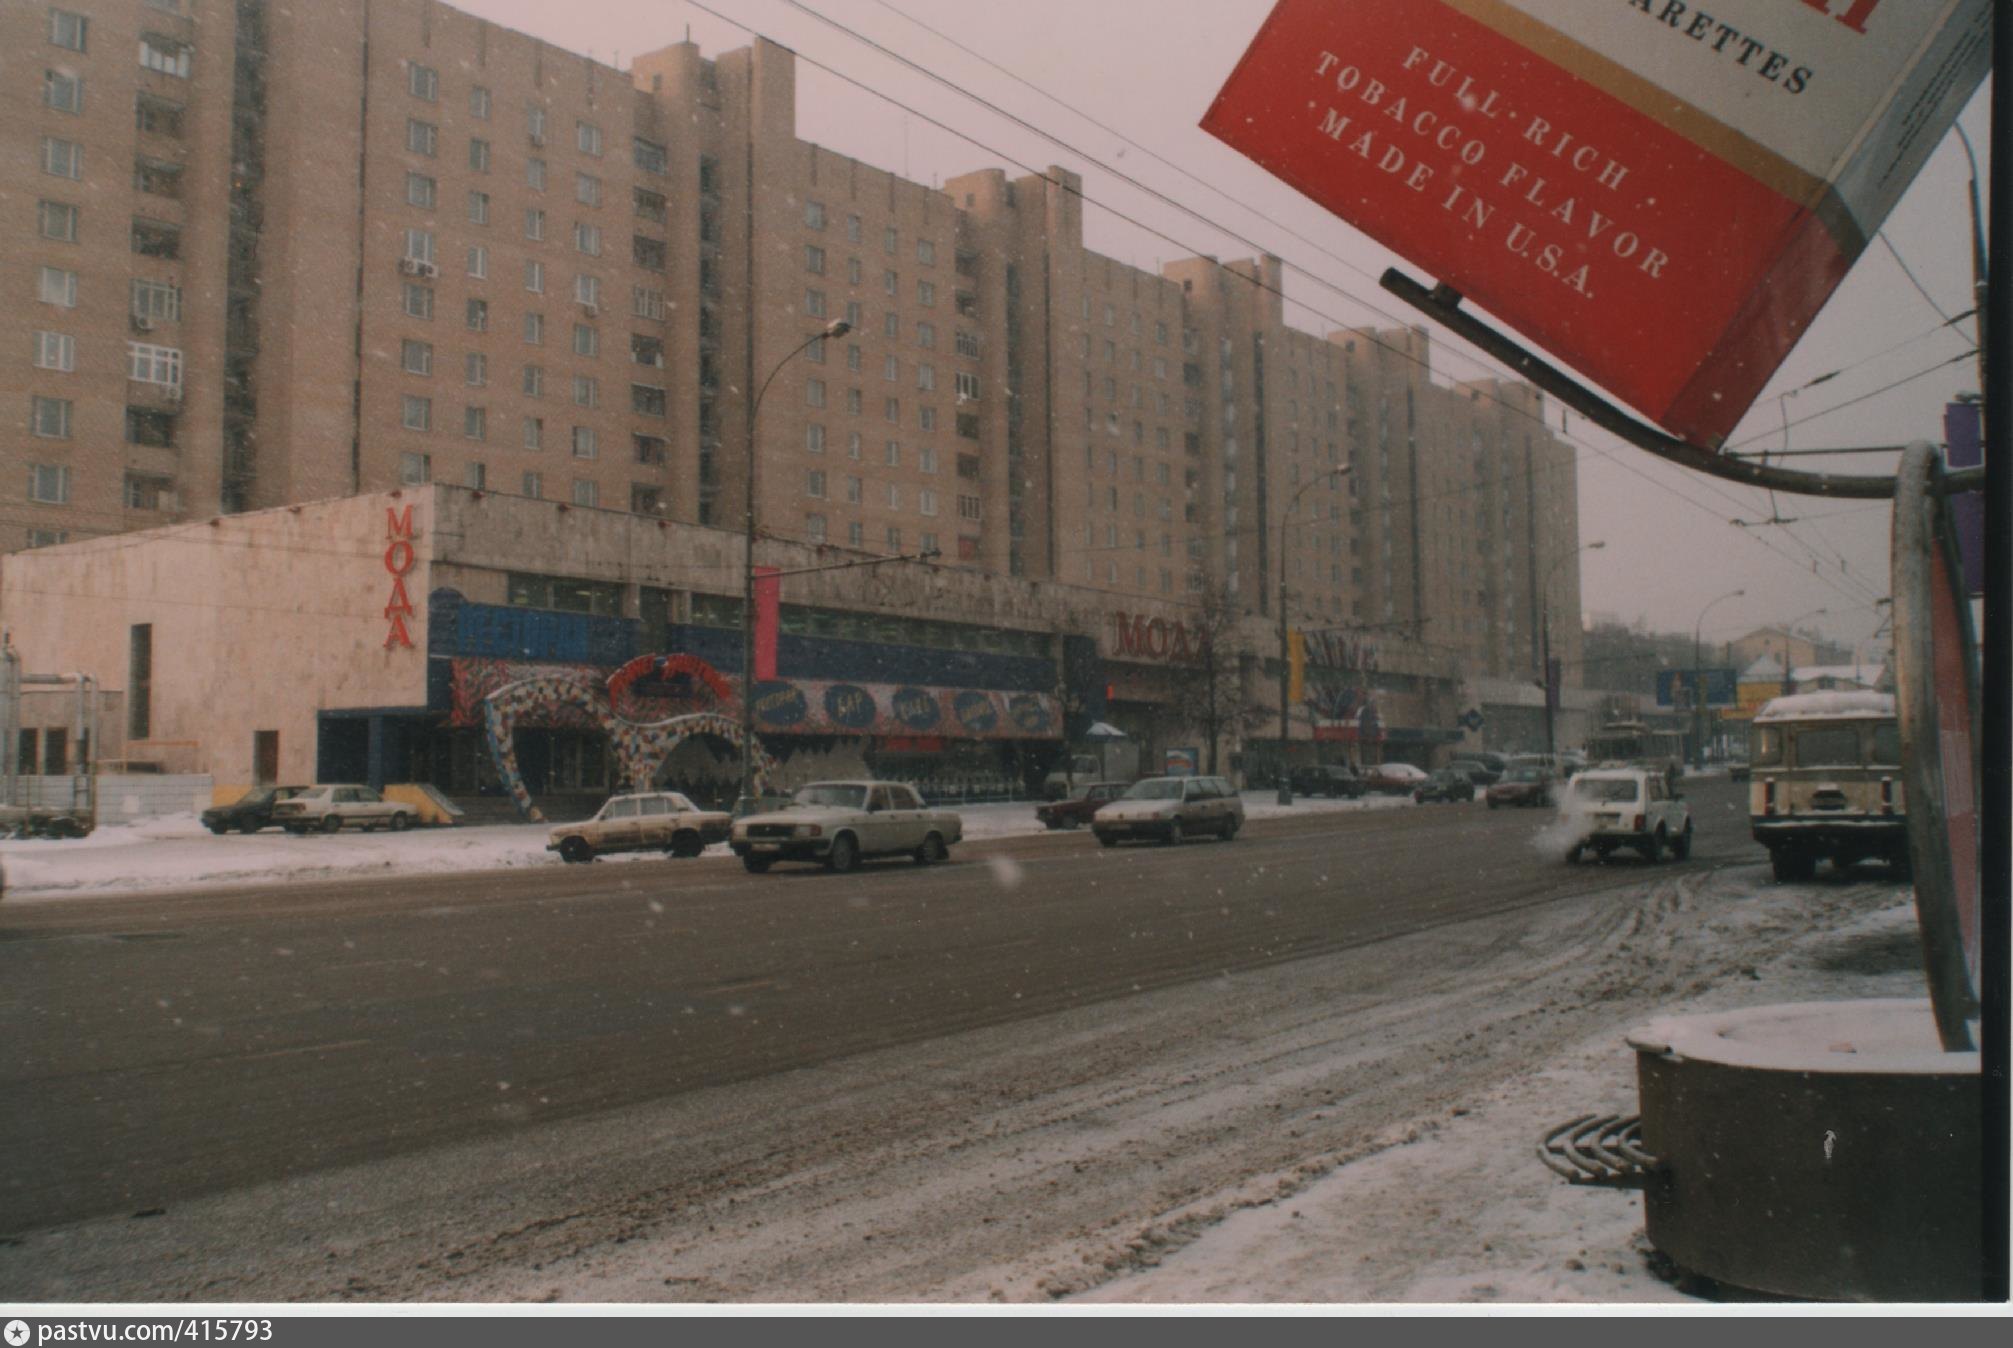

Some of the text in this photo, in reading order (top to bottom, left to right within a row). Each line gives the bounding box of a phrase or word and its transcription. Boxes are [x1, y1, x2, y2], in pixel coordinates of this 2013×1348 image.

[1314, 51, 1669, 279] TOBACCO FLAVOR
[1402, 46, 1630, 191] FULL RICH
[1317, 107, 1594, 299] MADE IN U.S.A.
[384, 503, 414, 648] МОДА
